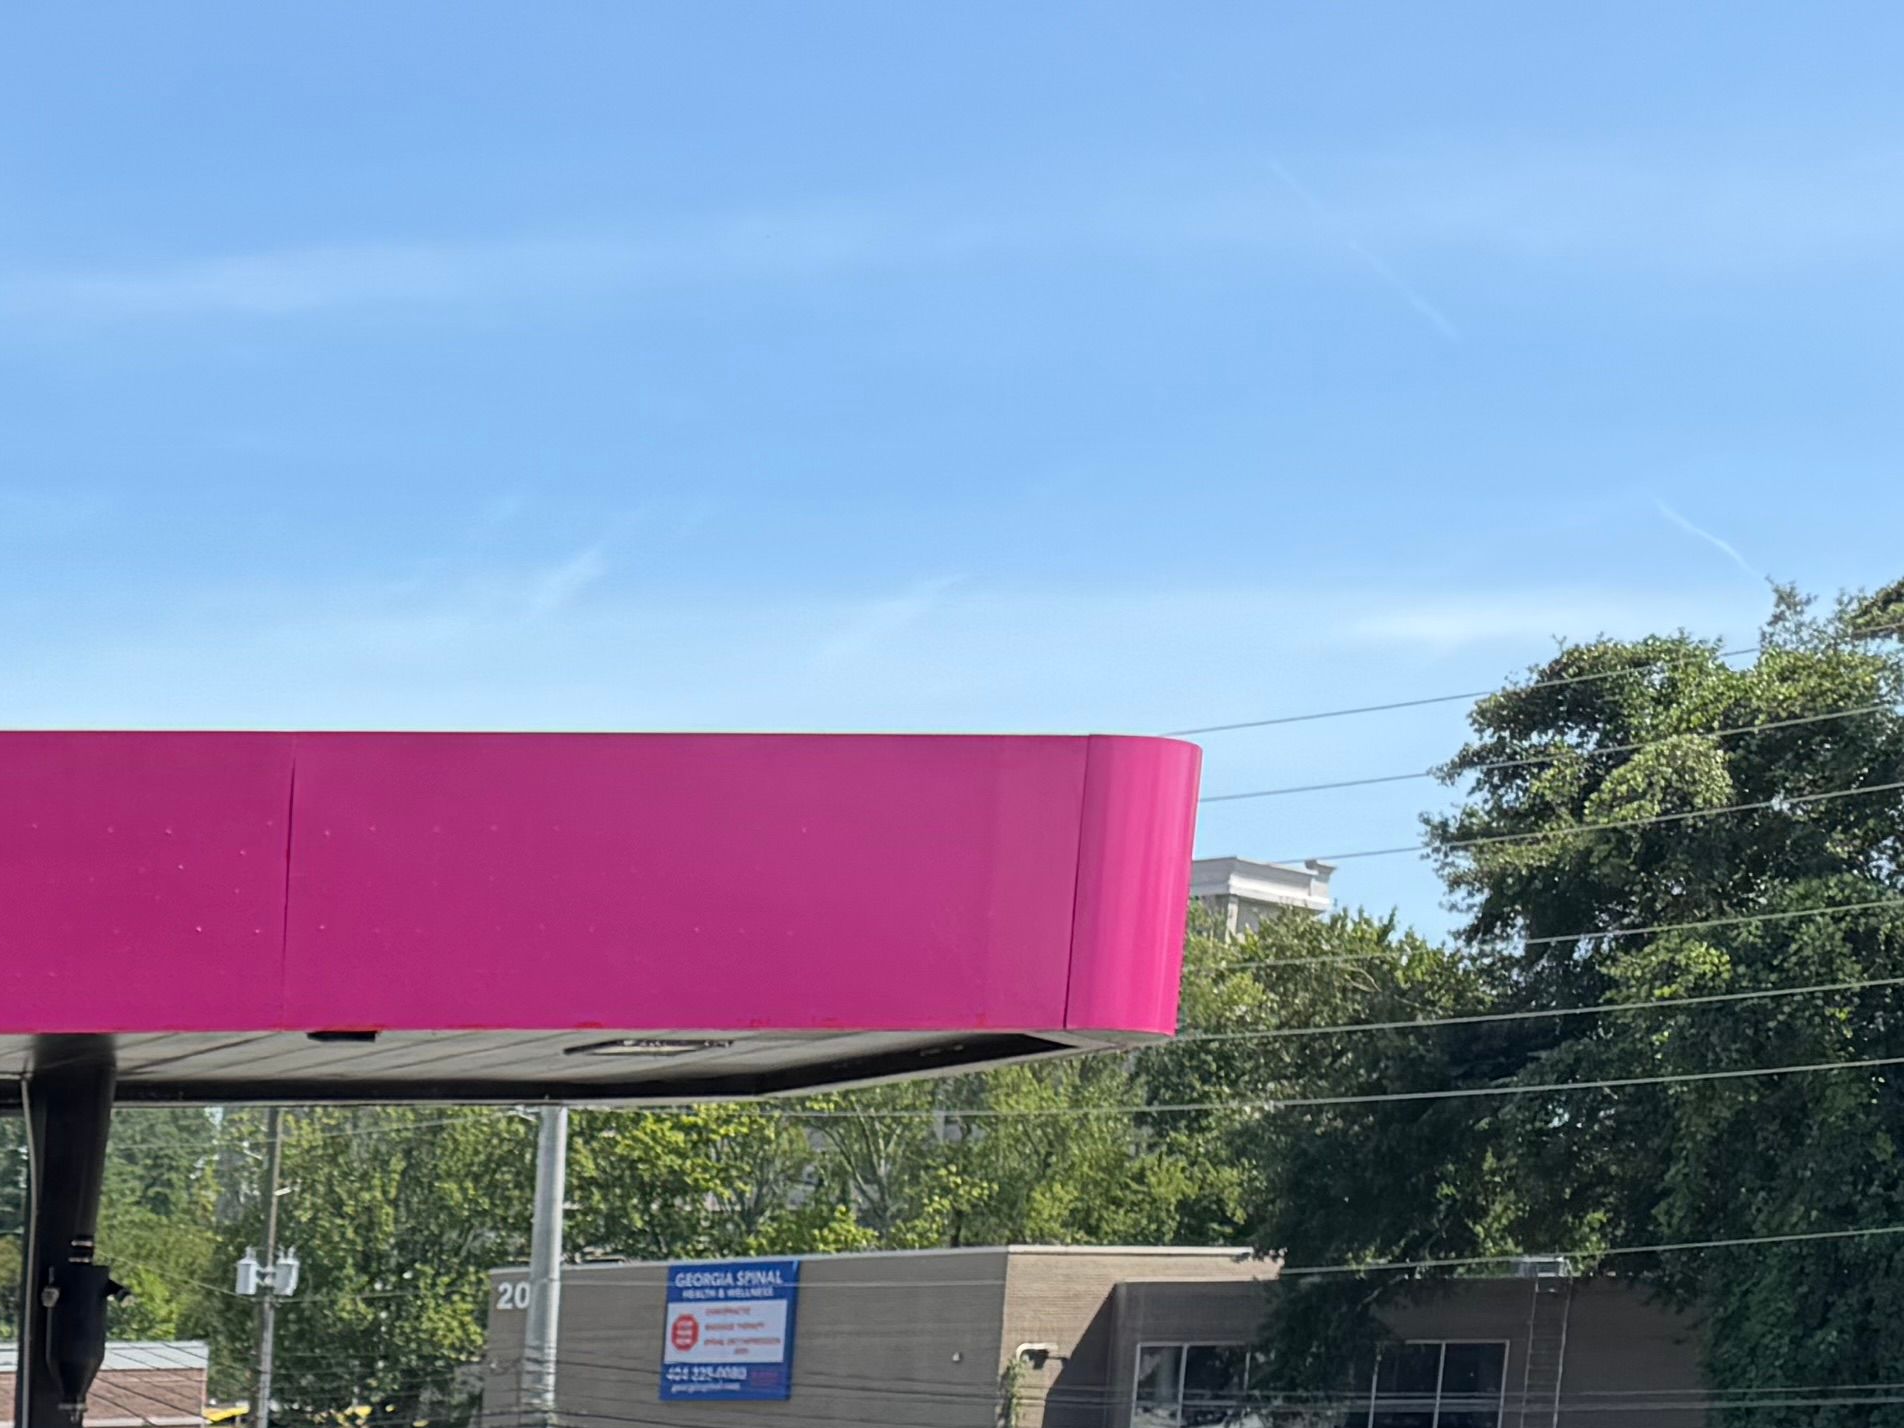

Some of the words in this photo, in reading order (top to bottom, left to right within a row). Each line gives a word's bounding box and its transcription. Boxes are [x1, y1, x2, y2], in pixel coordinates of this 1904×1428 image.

[675, 1271, 734, 1288] GEORGIA
[736, 1269, 783, 1285] SPINAL
[496, 1281, 530, 1310] 20
